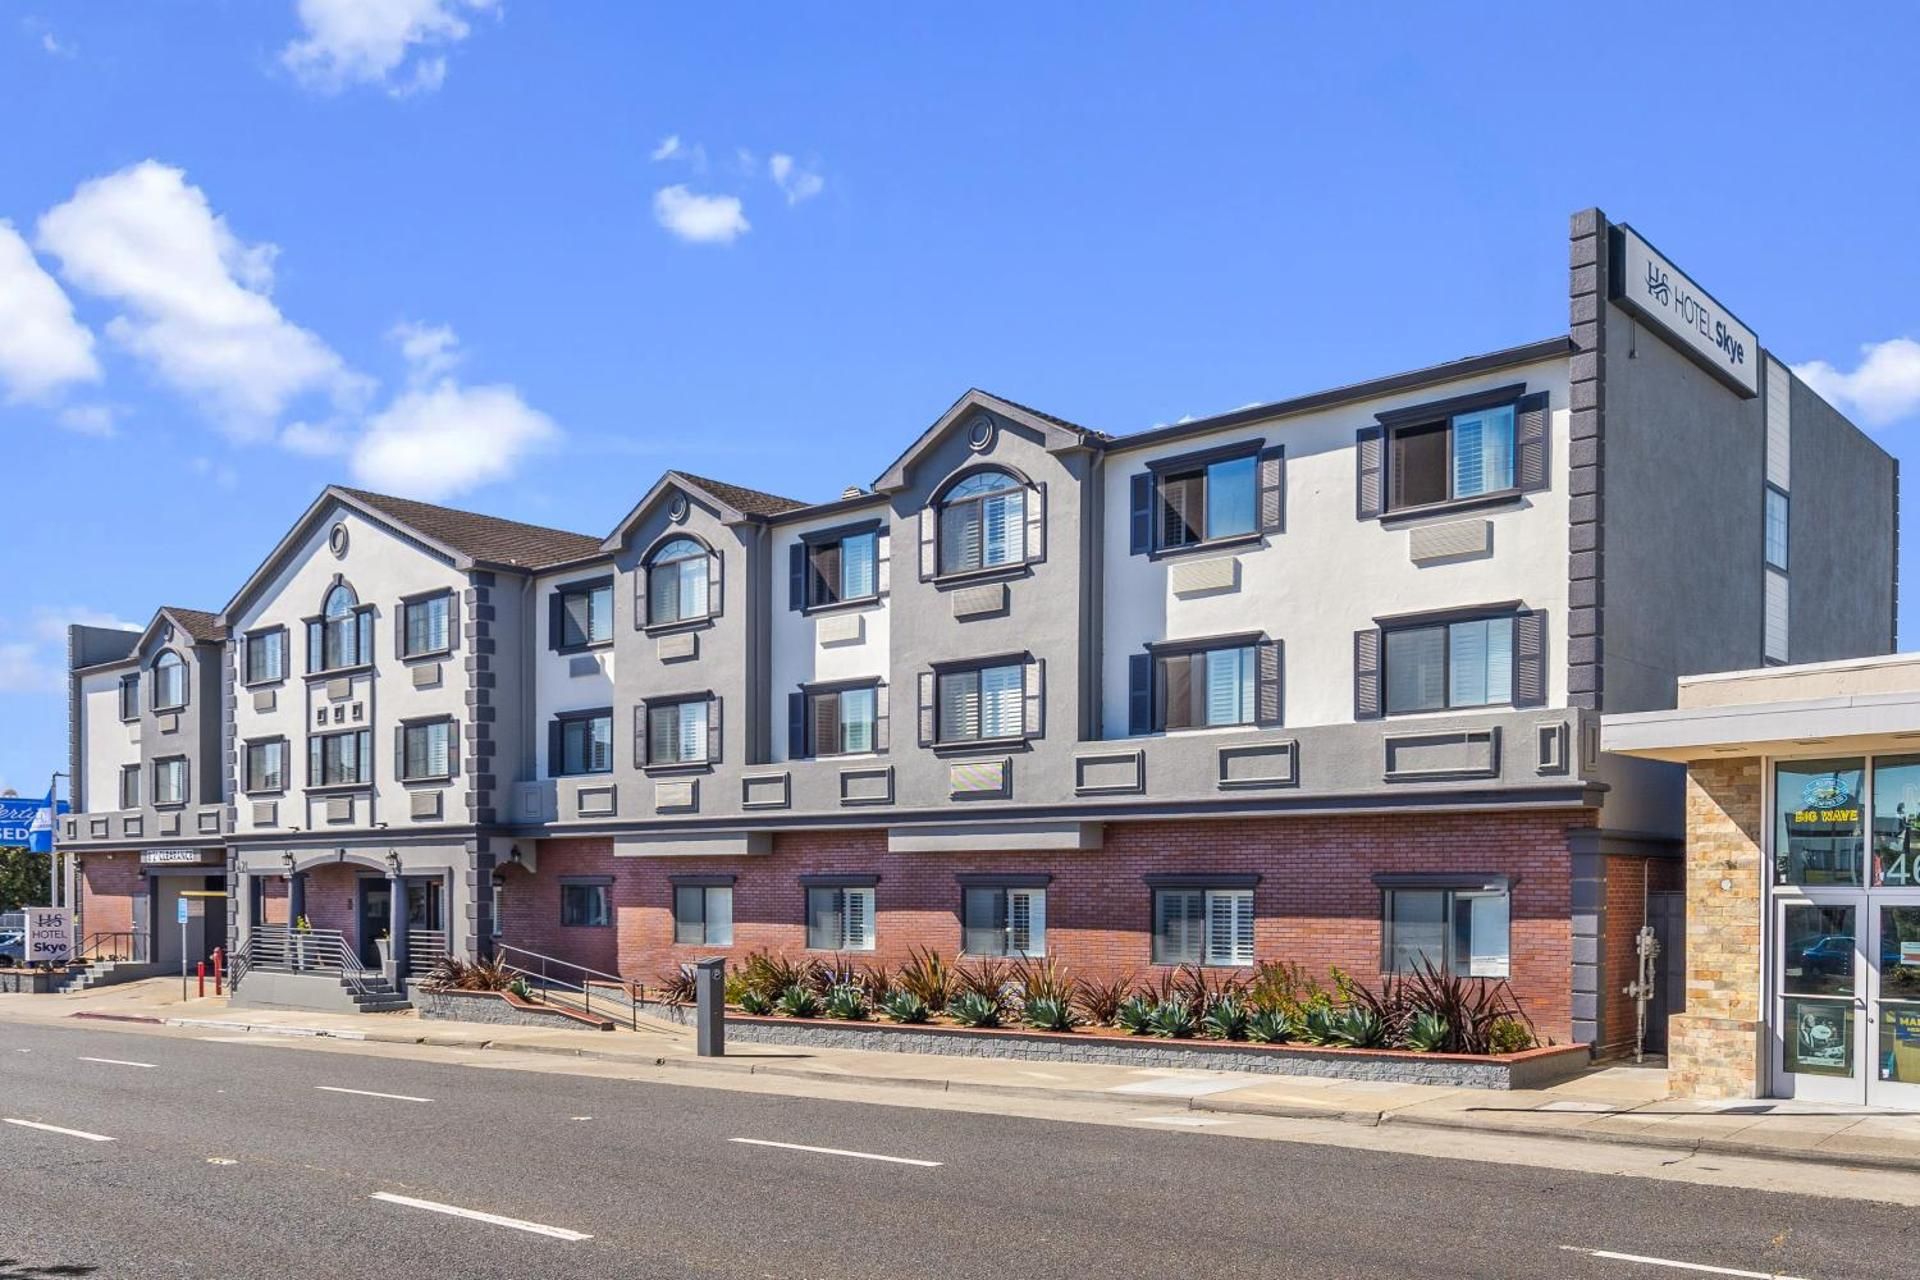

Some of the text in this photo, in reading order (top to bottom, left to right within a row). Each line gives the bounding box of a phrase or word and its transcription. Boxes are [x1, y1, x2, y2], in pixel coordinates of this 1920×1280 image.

[1675, 286, 1714, 343] HOTEL
[1715, 320, 1744, 364] Skye
[1822, 809, 1858, 822] WAVE
[0, 828, 29, 840] ED
[32, 930, 67, 939] HOTEL
[34, 941, 67, 954] Skye
